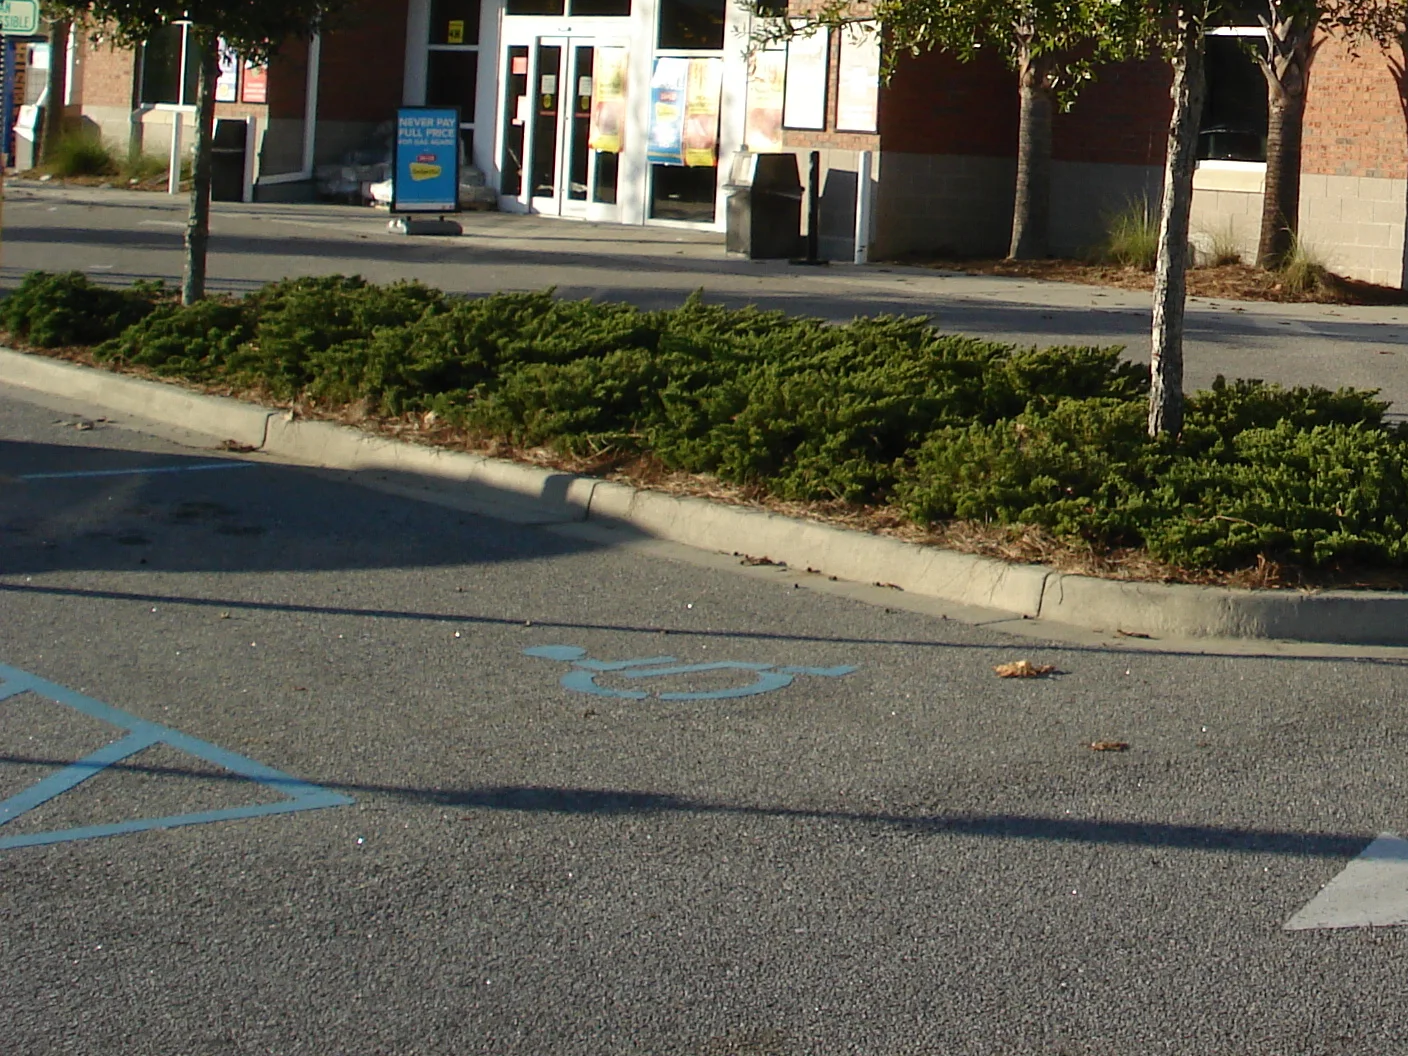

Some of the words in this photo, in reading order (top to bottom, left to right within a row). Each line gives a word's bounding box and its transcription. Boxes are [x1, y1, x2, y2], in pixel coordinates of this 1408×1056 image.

[398, 117, 434, 127] NEVER
[436, 118, 456, 128] PAY
[398, 127, 423, 137] FULL
[425, 128, 456, 138] PRICE
